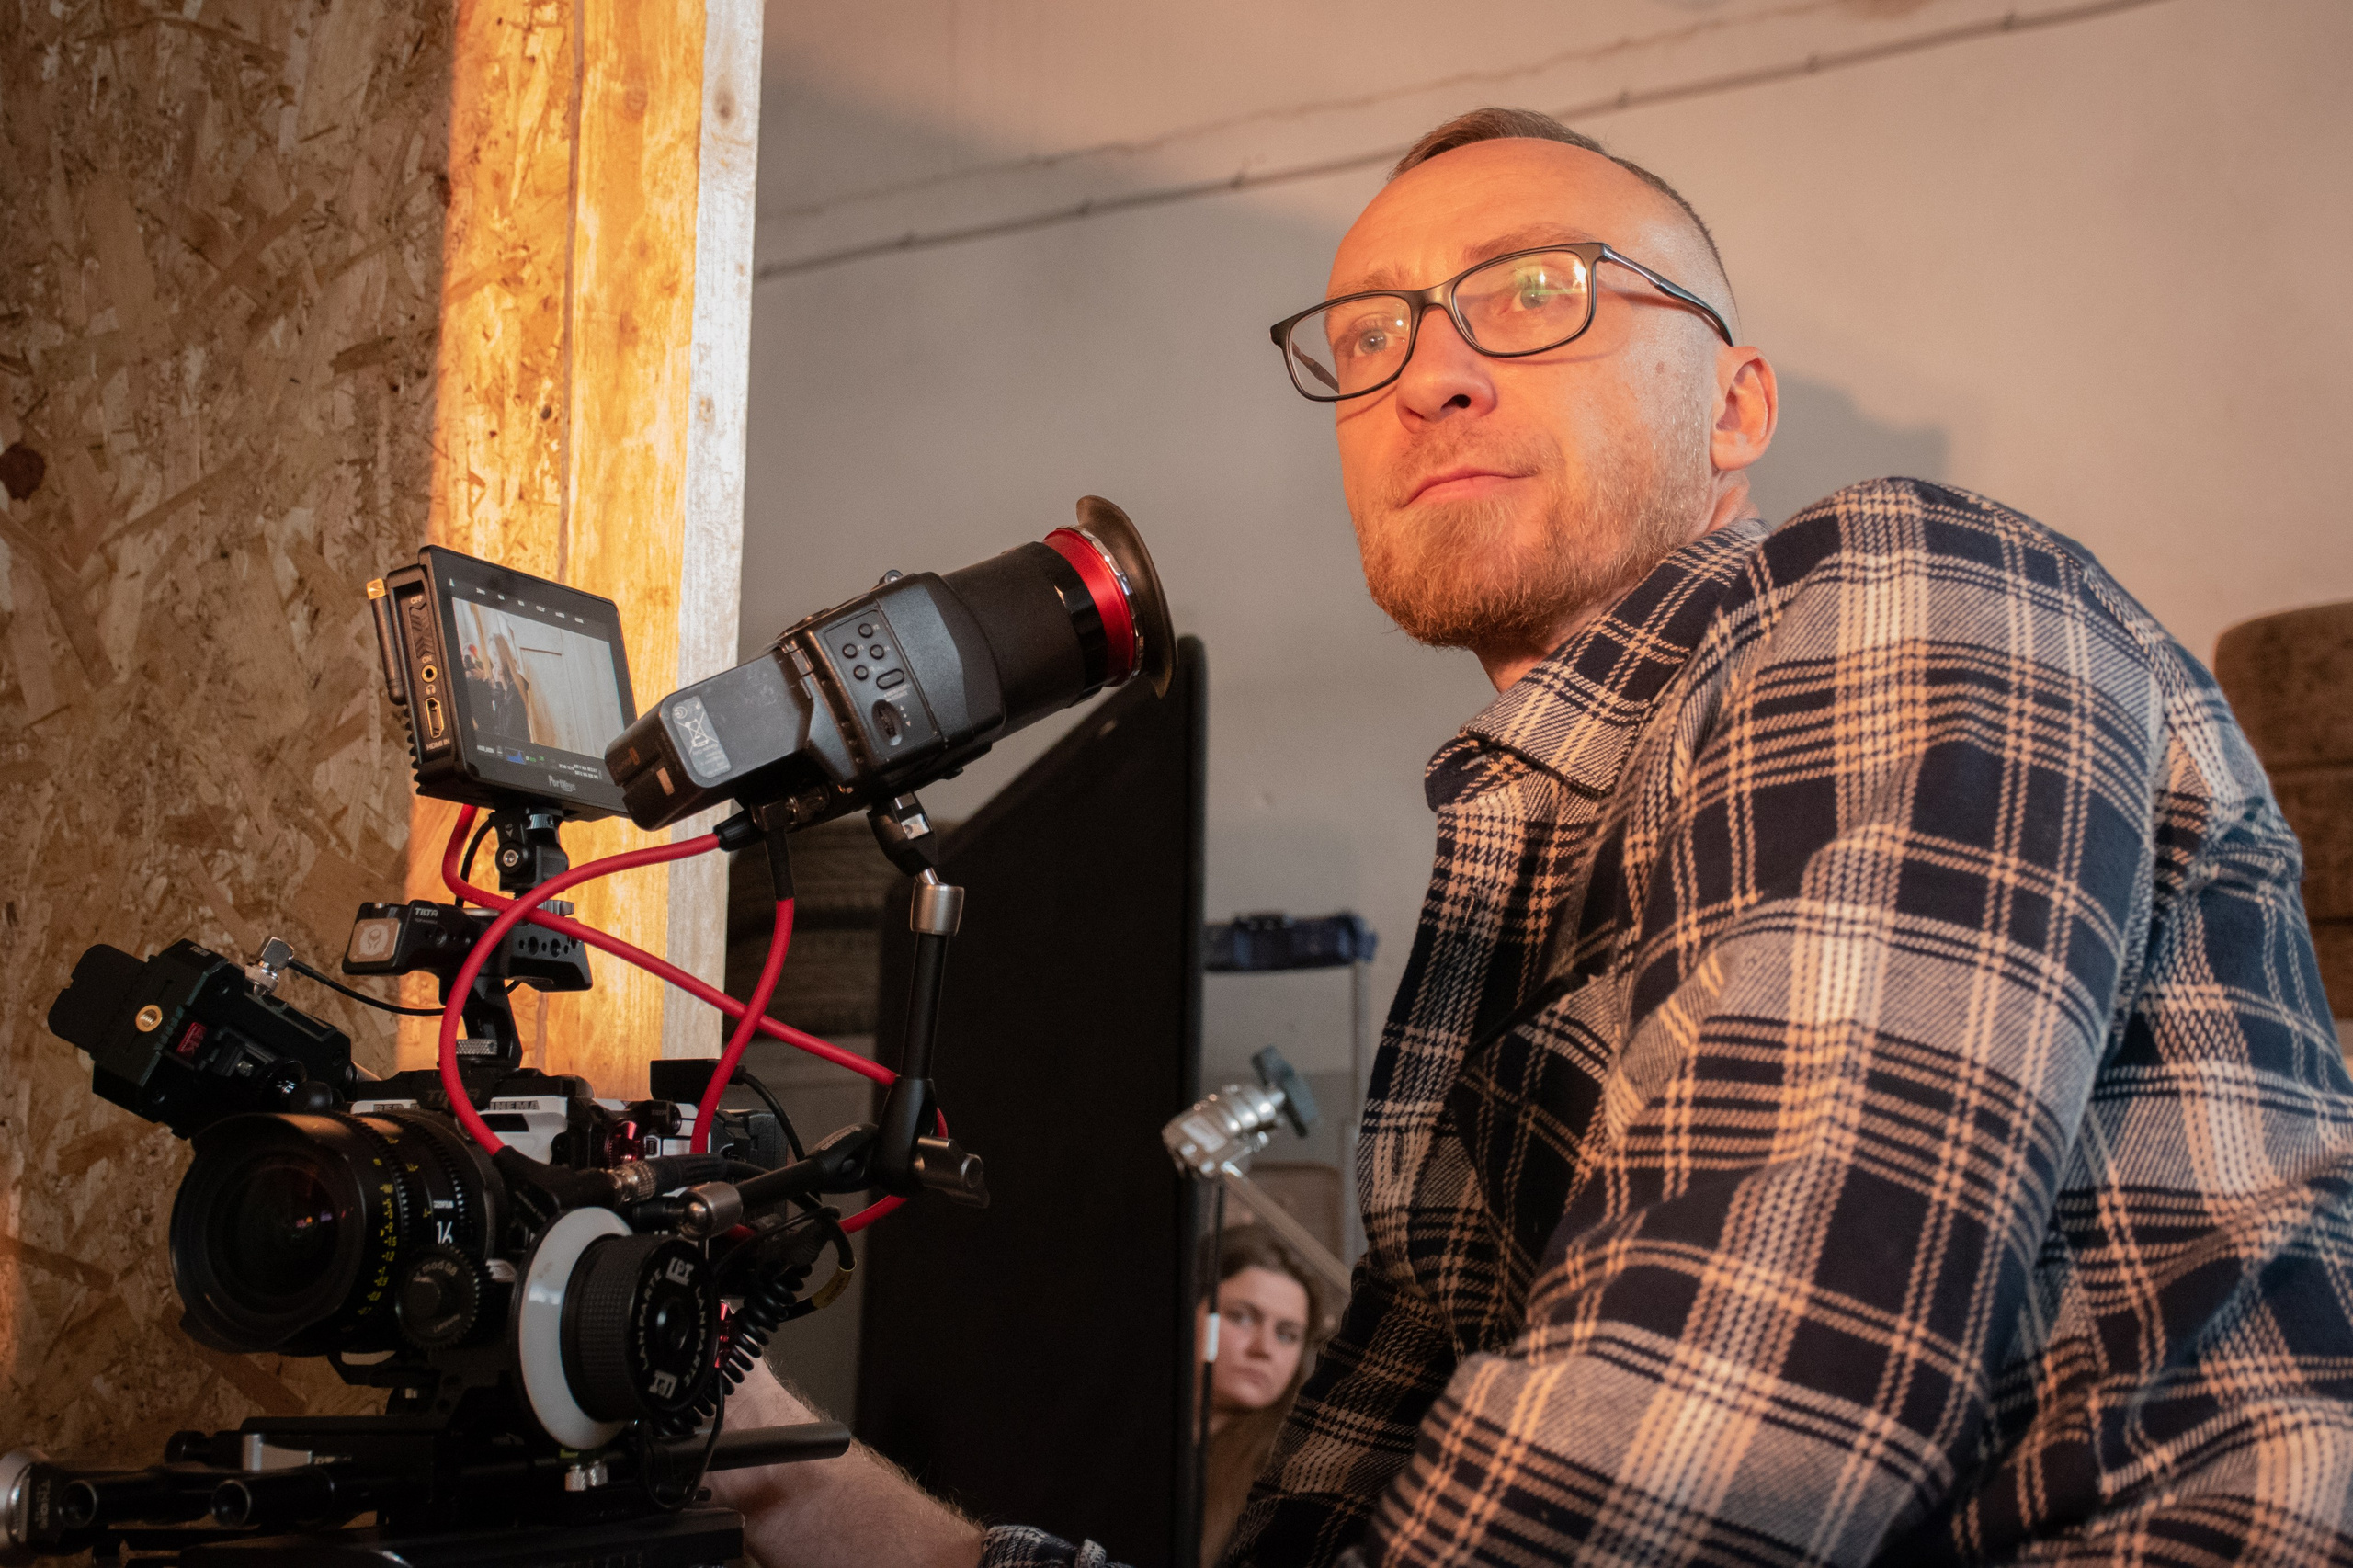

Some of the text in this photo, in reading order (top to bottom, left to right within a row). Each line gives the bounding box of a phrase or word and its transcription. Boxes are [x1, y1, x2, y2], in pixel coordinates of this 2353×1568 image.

[410, 595, 424, 605] OFF
[421, 655, 433, 664] ON
[426, 738, 451, 752] HDMI IN
[415, 907, 439, 917] TILTA
[489, 1099, 540, 1110] INEMA
